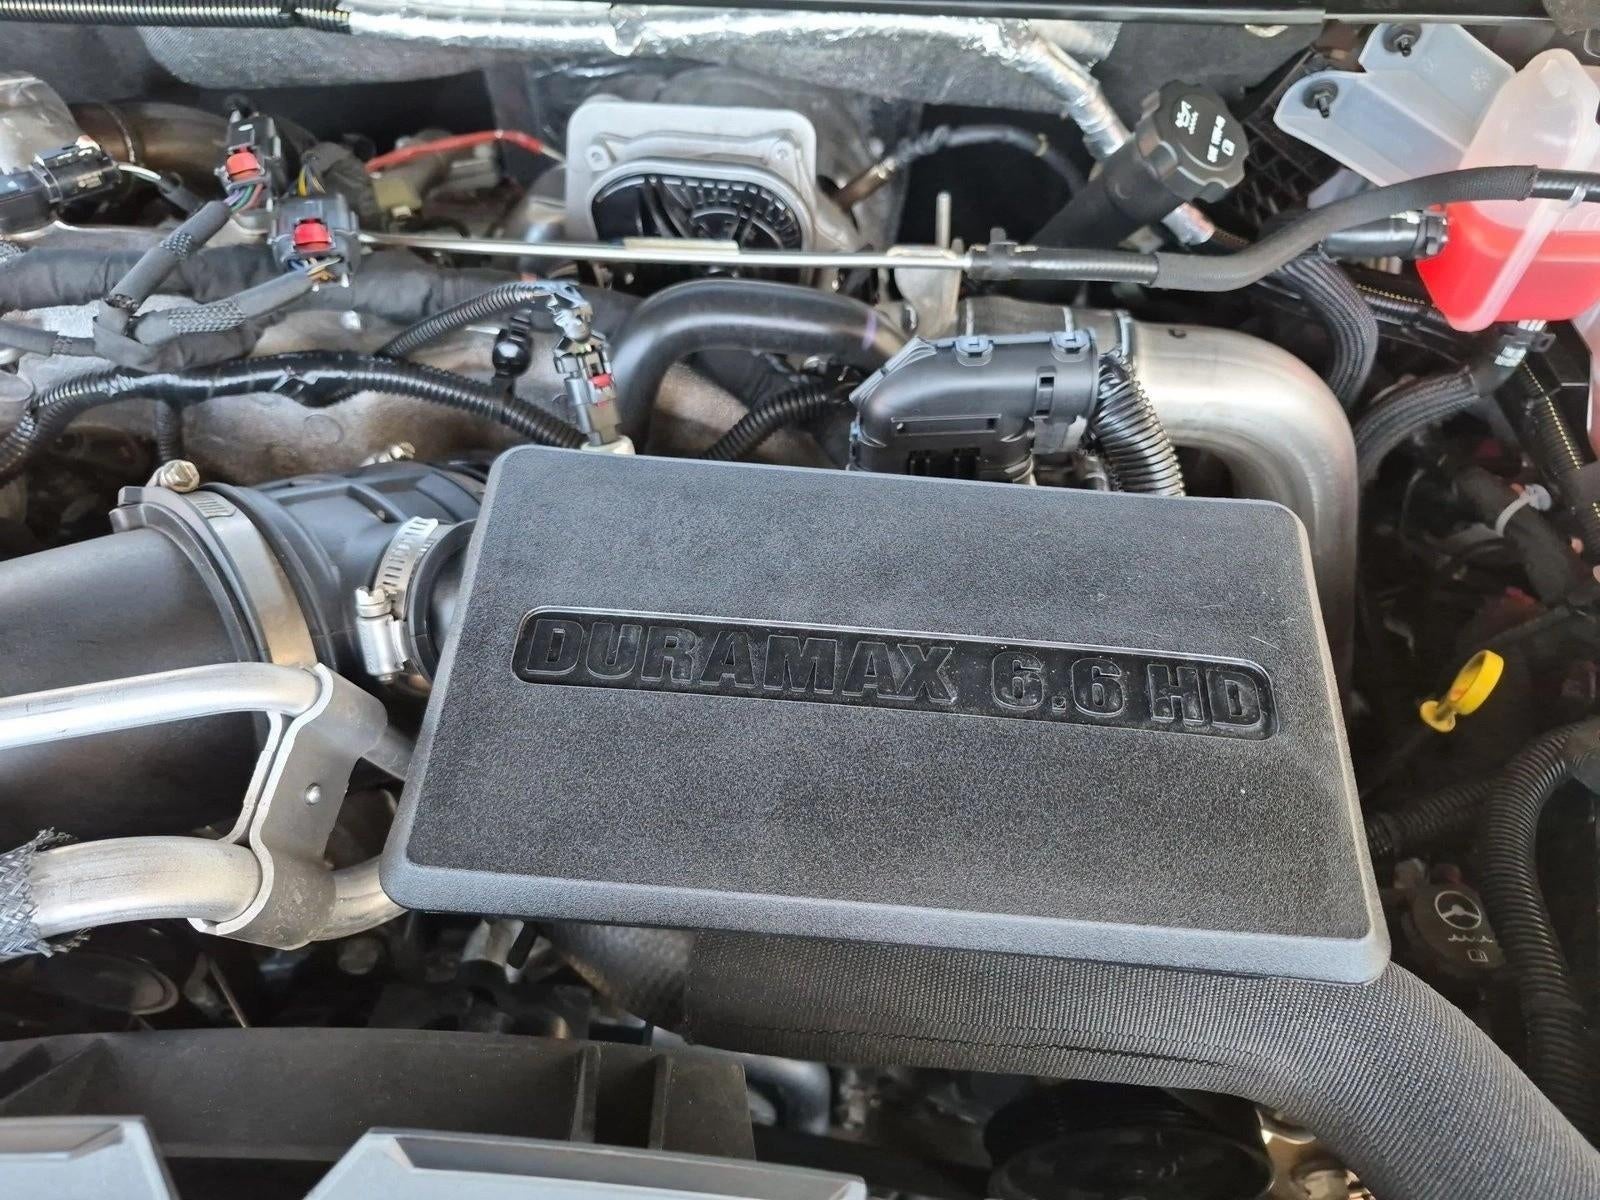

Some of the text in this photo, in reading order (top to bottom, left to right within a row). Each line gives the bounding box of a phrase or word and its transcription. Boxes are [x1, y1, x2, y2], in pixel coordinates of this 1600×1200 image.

[525, 618, 1263, 728] DURAMAX 6.6 HD
